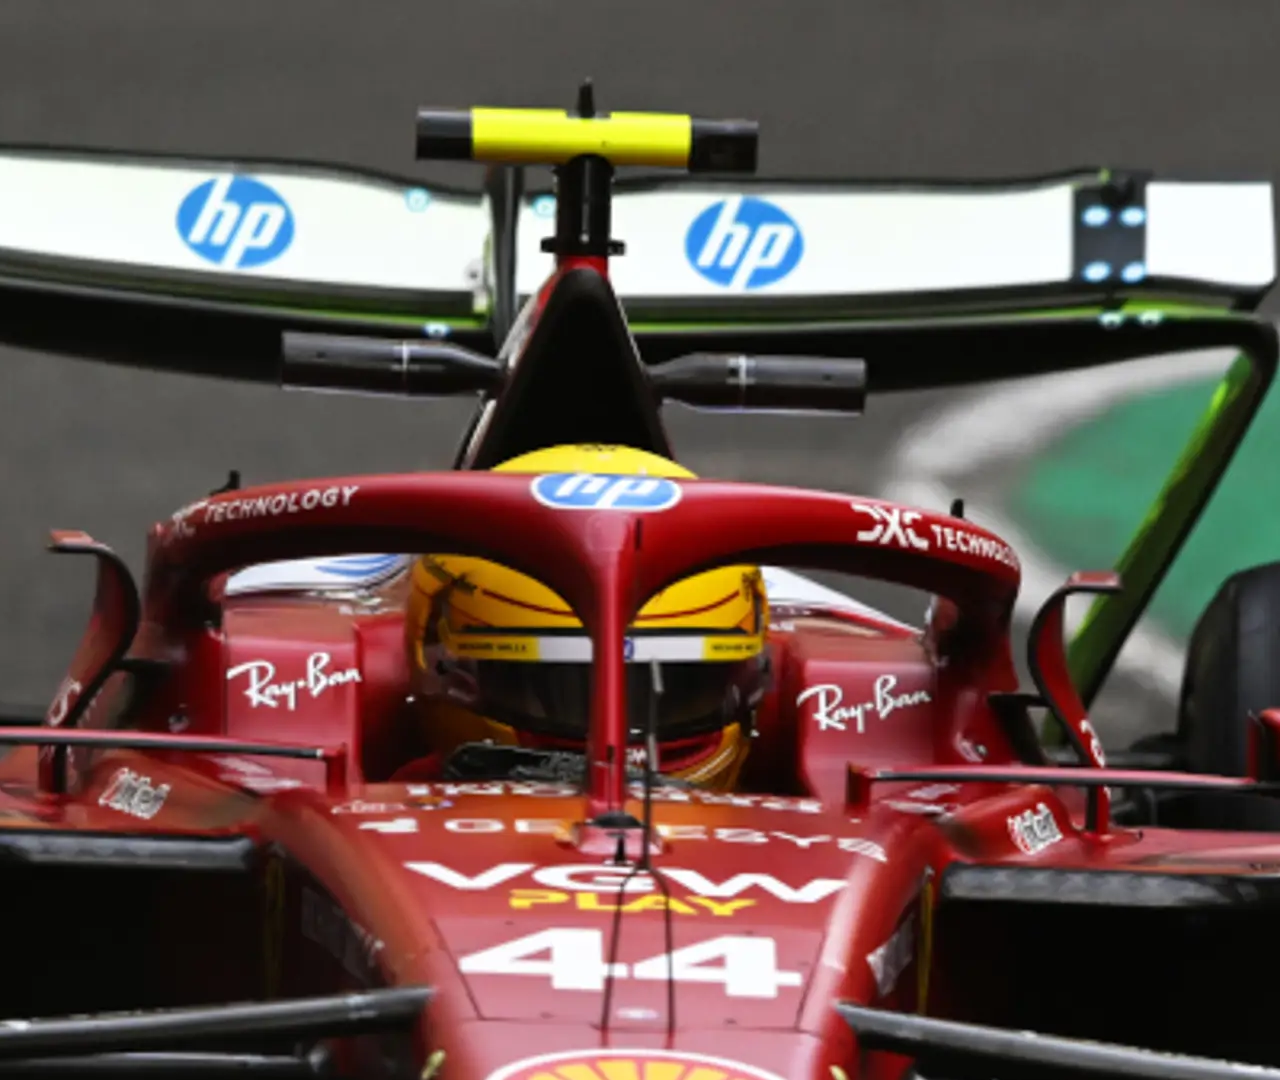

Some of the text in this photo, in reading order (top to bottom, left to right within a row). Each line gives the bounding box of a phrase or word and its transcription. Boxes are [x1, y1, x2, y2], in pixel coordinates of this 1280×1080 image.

[189, 176, 285, 268] hp
[696, 197, 794, 289] hp
[205, 486, 360, 524] TECHNOLOGY
[554, 473, 661, 507] hp
[851, 502, 929, 551] DXC
[226, 651, 362, 711] Ray-Ban
[796, 674, 932, 733] Ray-Ban
[444, 817, 888, 862] GEESYS
[404, 862, 850, 903] VGW
[509, 888, 757, 916] PLAY
[459, 928, 803, 998] 44
